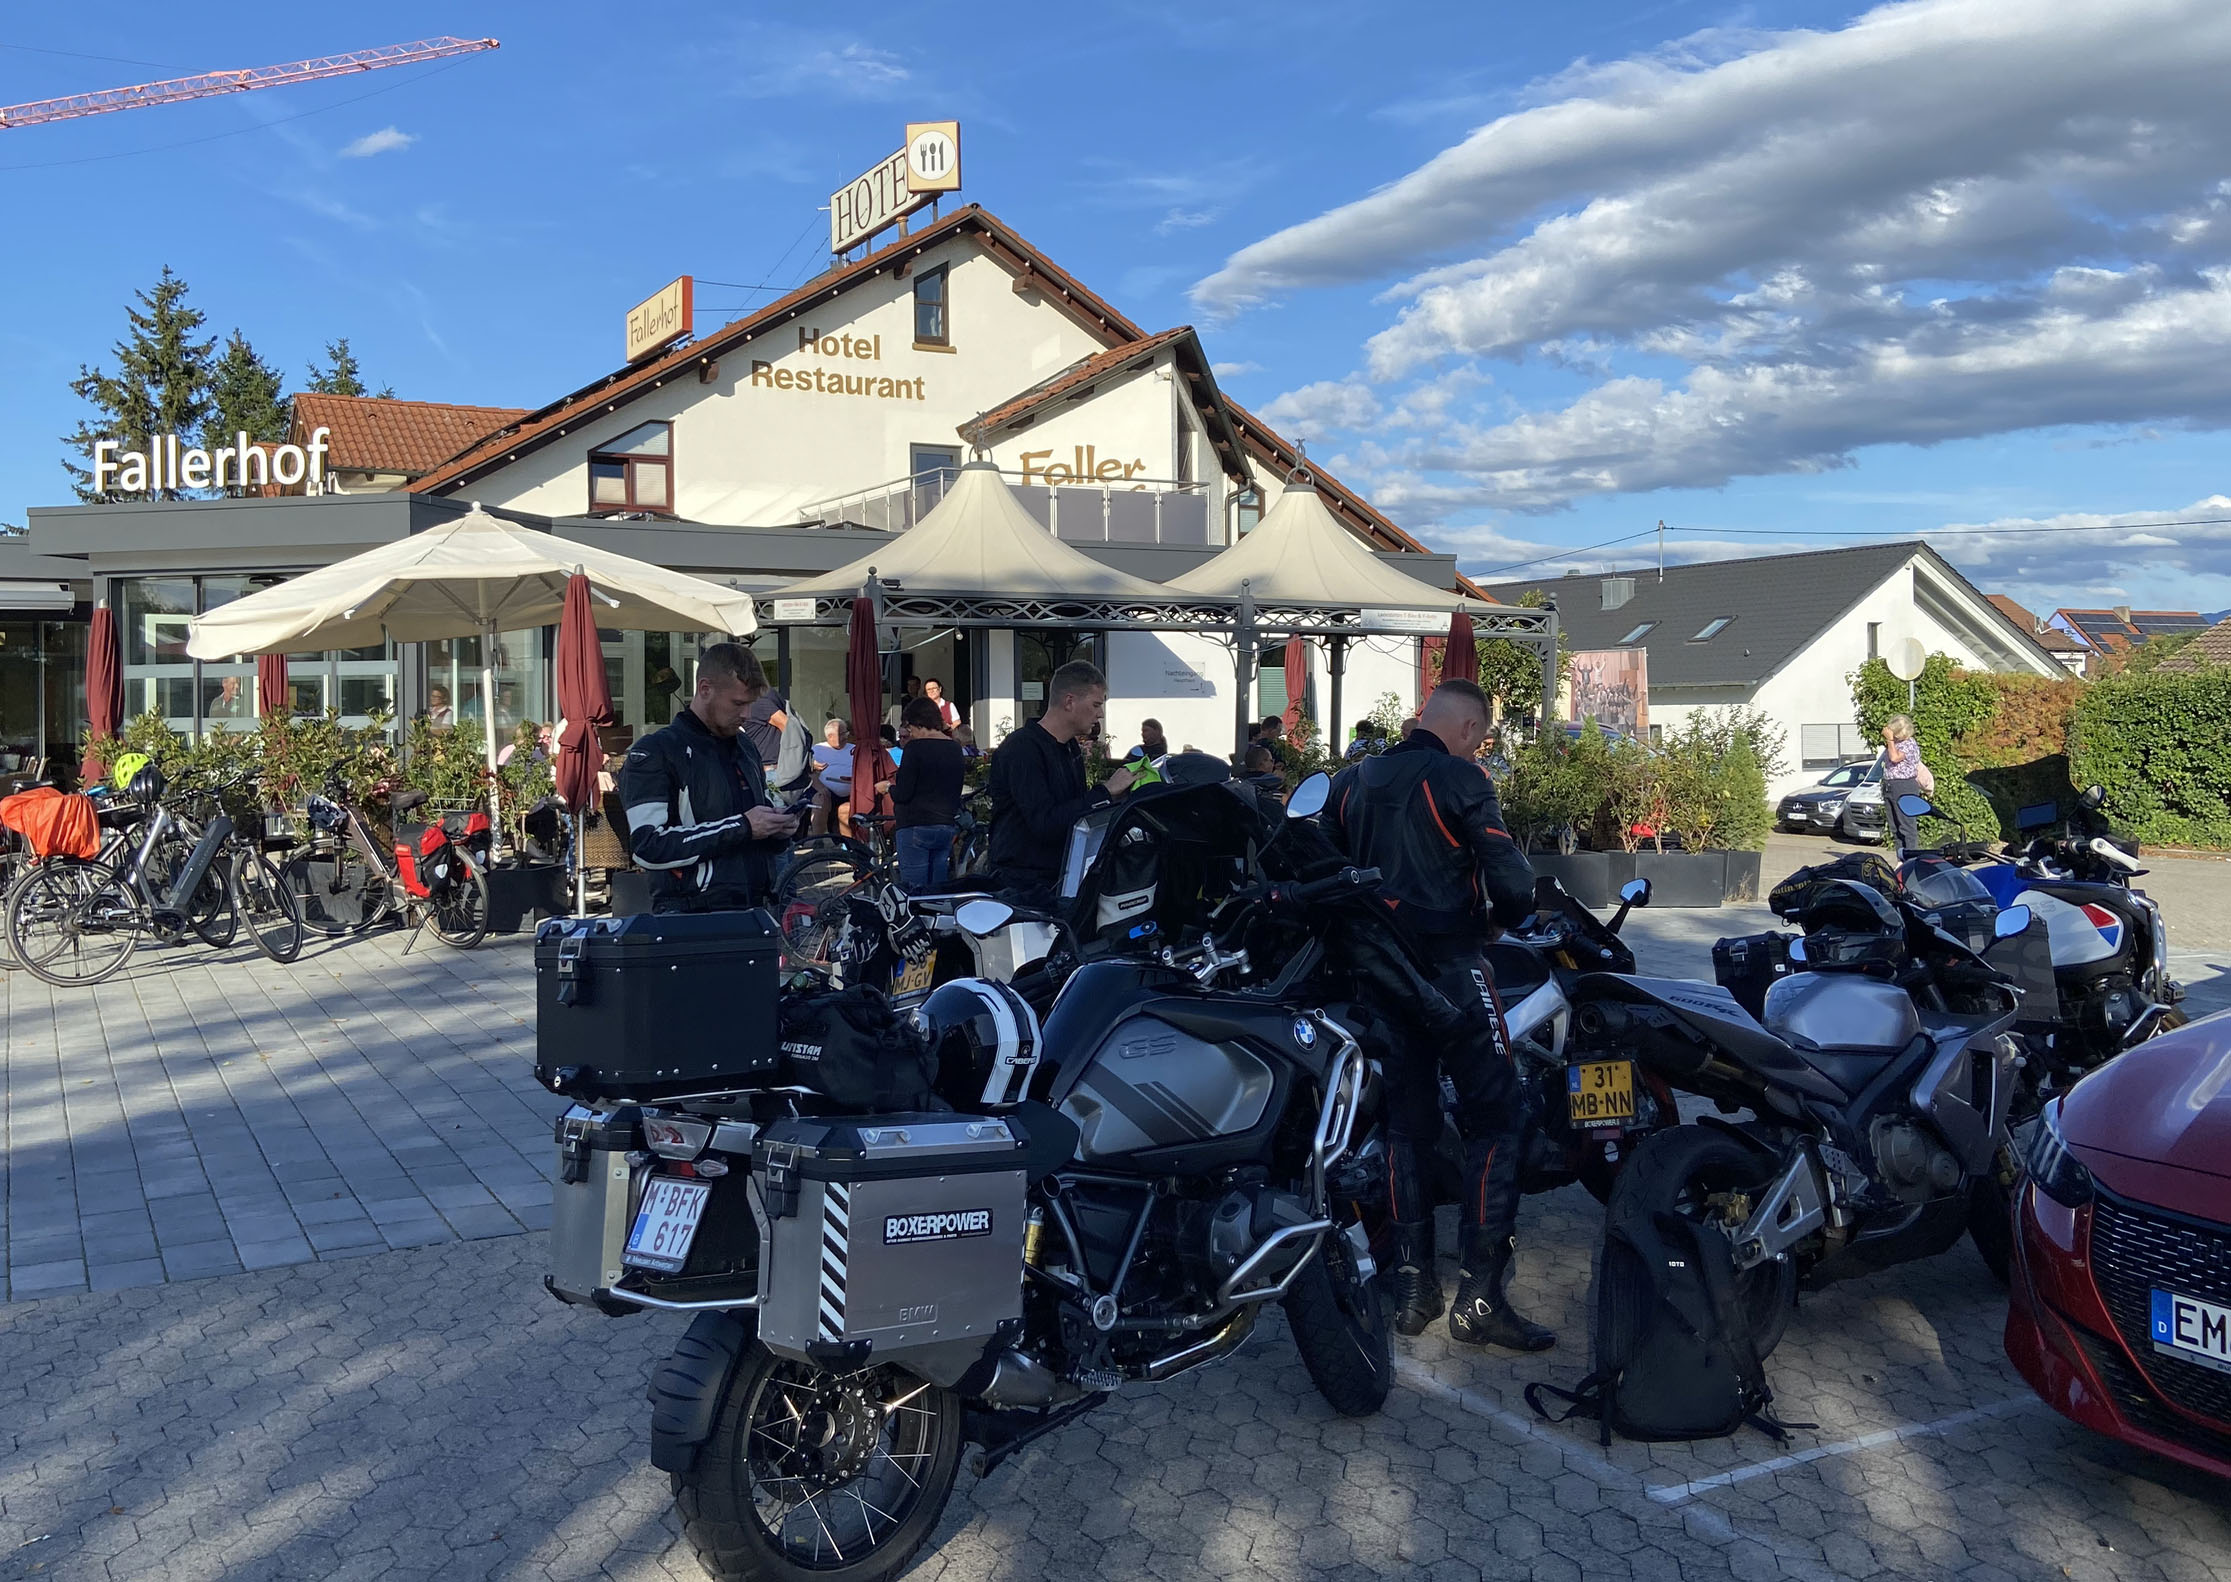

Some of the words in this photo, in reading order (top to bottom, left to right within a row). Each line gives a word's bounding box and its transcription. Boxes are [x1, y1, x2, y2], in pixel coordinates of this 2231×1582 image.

[835, 153, 918, 244] HOTE
[629, 280, 680, 348] Fallerhof
[799, 326, 881, 361] Hotel
[751, 360, 925, 401] Restaurant
[95, 427, 331, 493] Fallerhof
[1020, 444, 1146, 487] Faller
[1470, 968, 1508, 1056] DAINESE
[1119, 1032, 1177, 1060] GS
[1594, 1065, 1613, 1088] 31
[1572, 1090, 1632, 1117] MB-NN
[653, 1221, 694, 1255] 617
[886, 1211, 990, 1238] BOXERPOWER
[2158, 1320, 2167, 1333] D
